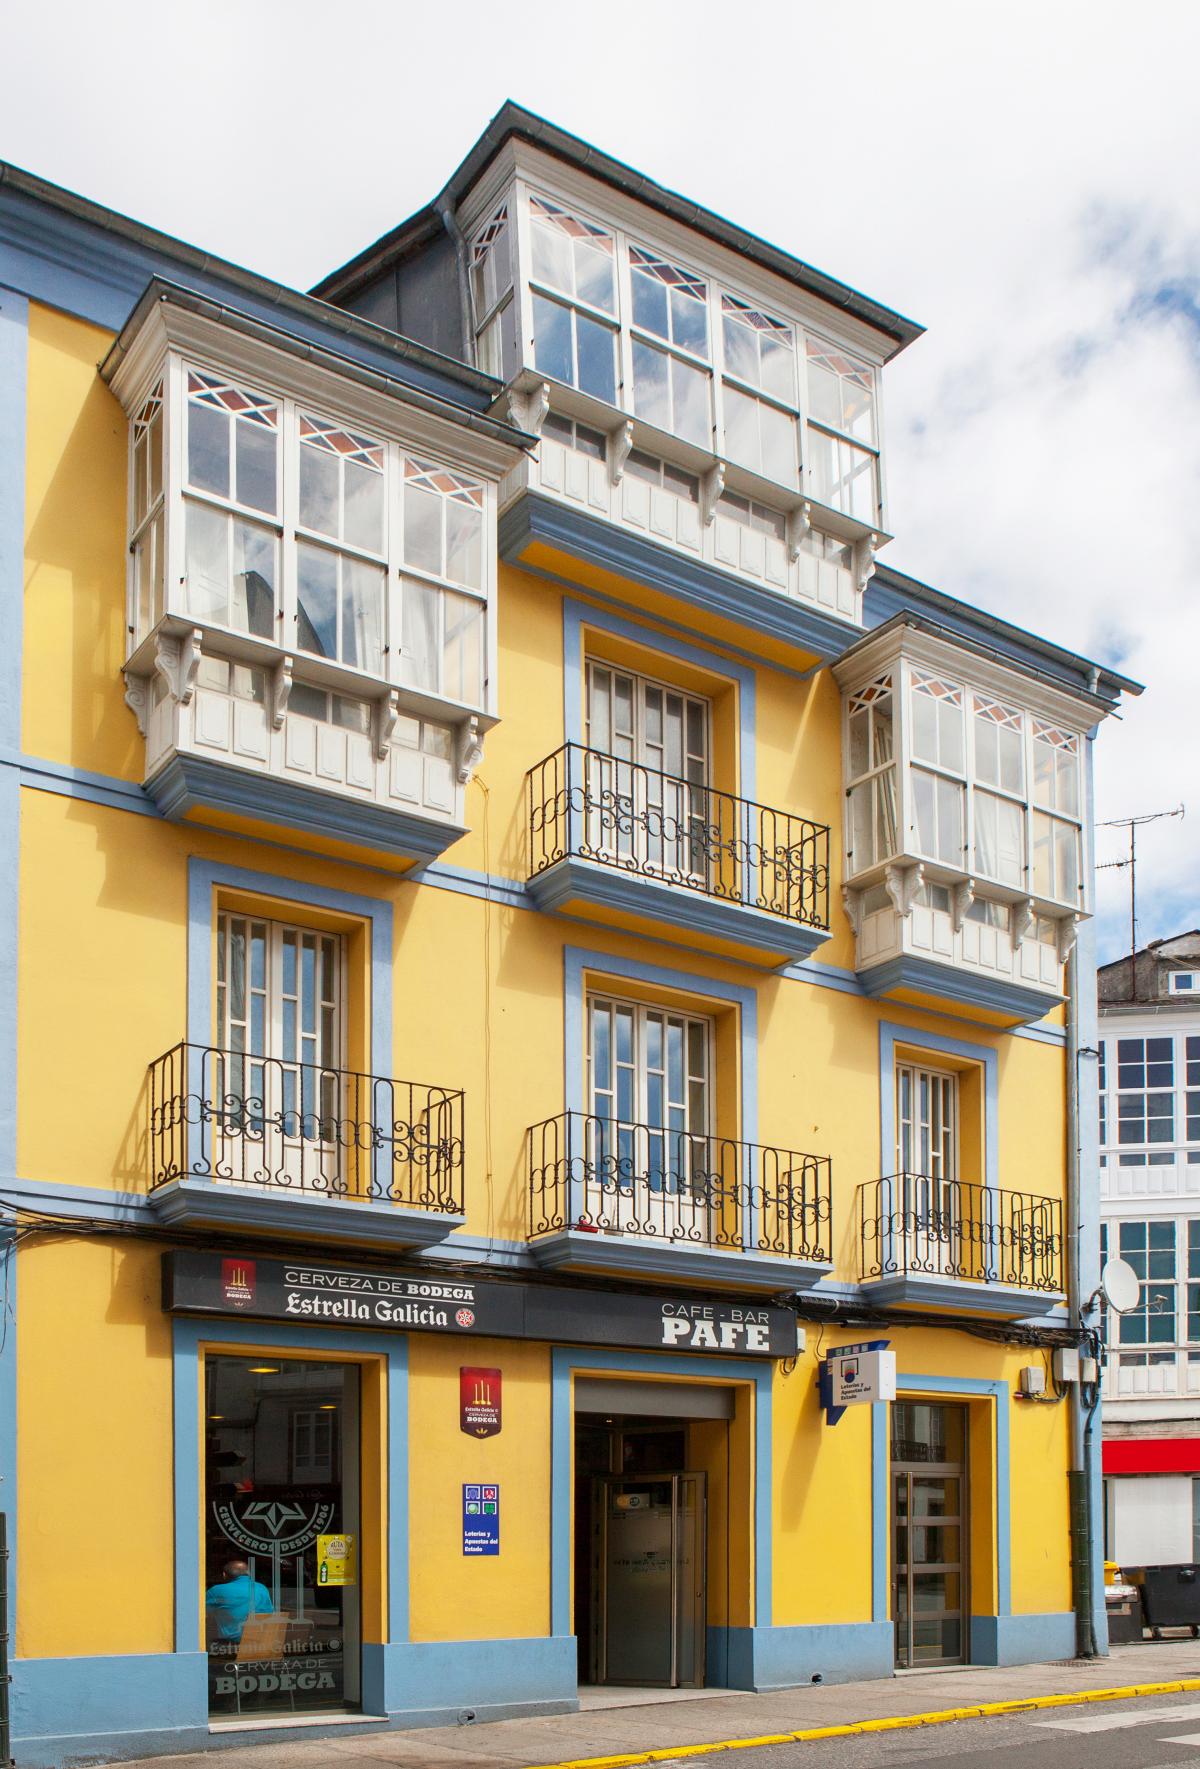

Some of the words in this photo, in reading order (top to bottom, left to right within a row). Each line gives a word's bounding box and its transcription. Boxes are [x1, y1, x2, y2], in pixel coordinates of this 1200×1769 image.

[285, 1271, 374, 1291] CERVEZA
[378, 1281, 402, 1293] DE
[407, 1283, 474, 1301] BODEGA
[285, 1292, 370, 1320] Estrella
[375, 1303, 448, 1326] Galicia
[661, 1303, 714, 1319] CAFE
[731, 1309, 769, 1324] BAR
[661, 1317, 770, 1351] PAFE
[280, 1530, 315, 1552] DESDE
[312, 1504, 329, 1530] 1906
[306, 1658, 328, 1669] DE
[215, 1672, 336, 1694] BODEGA
